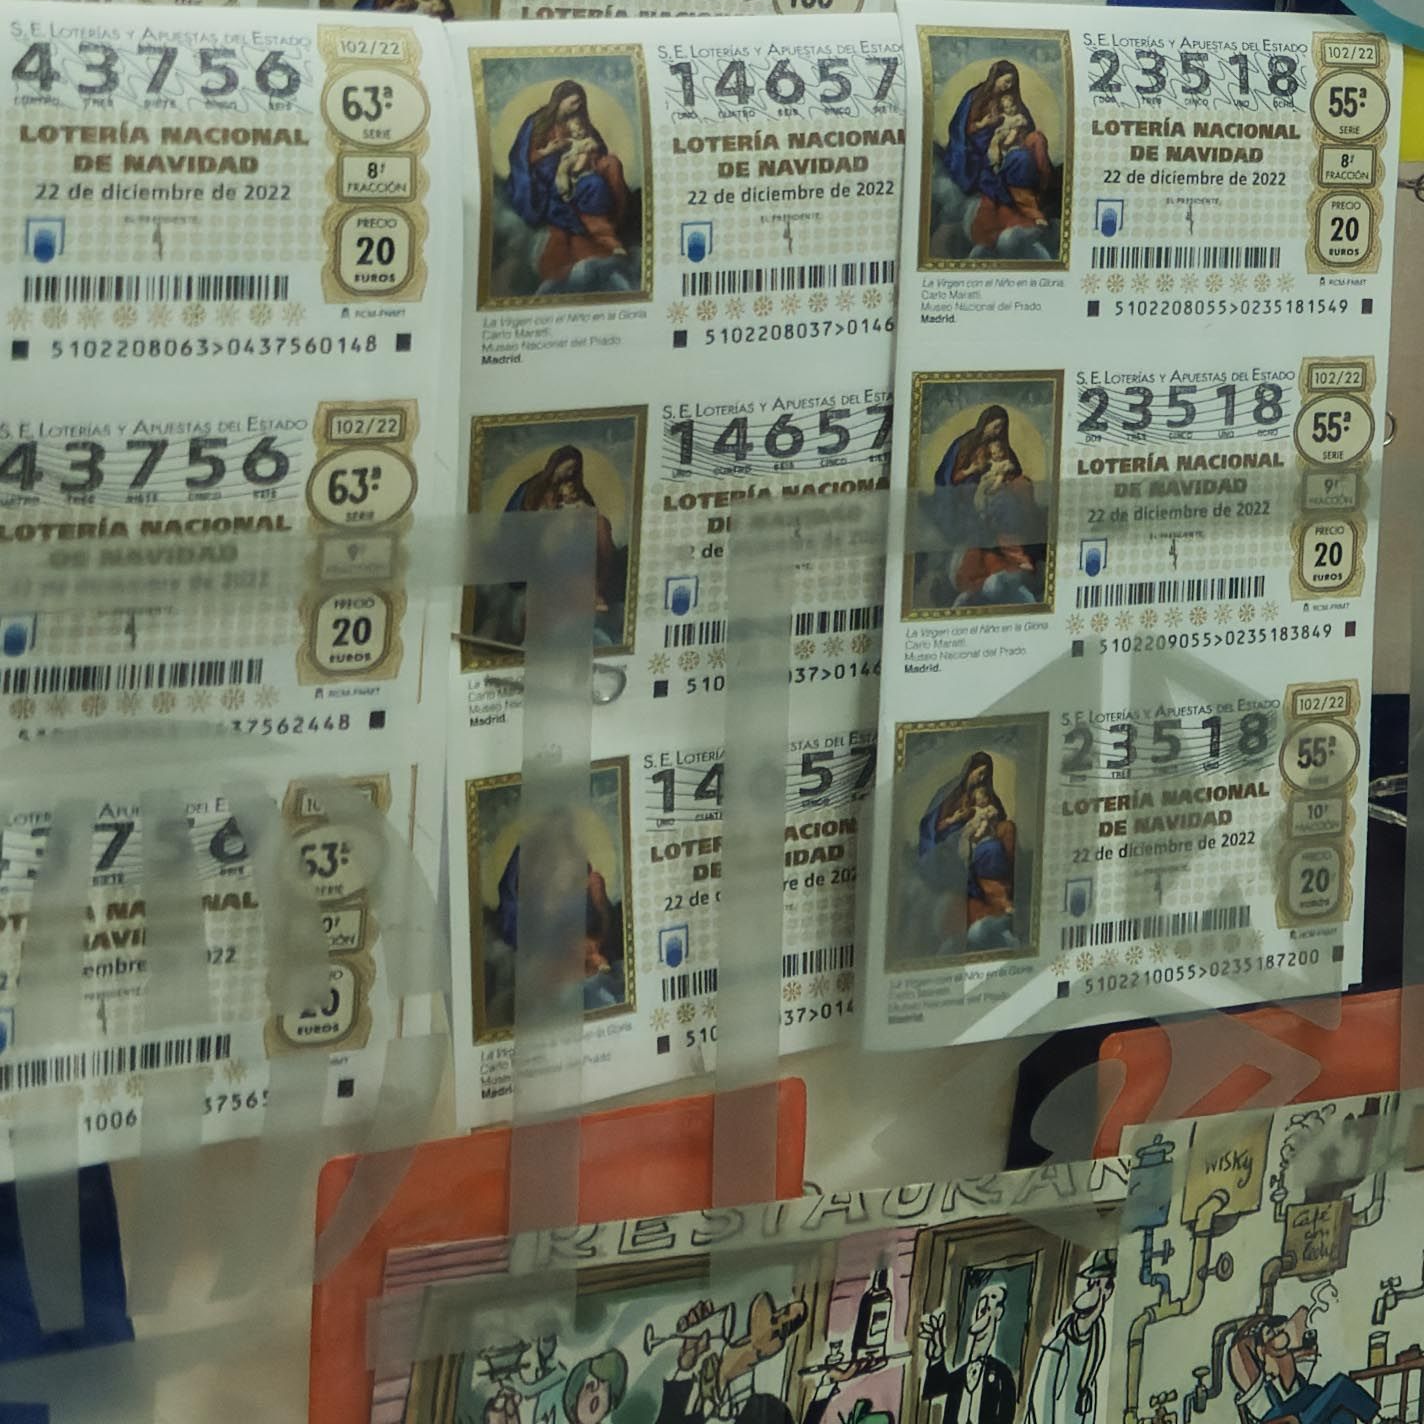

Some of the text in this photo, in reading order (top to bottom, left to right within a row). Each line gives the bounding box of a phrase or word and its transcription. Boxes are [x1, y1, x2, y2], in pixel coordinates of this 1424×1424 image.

[12, 41, 302, 99] 43756
[668, 56, 899, 107] 14657
[1088, 50, 1299, 97] 23518
[1092, 117, 1301, 141] LOTERÍA NACIONAL
[1130, 145, 1264, 164] DE NAVIDAD
[1329, 217, 1359, 242] 20
[355, 236, 395, 266] 20
[1078, 383, 1285, 434] 23518
[0, 436, 291, 493] 43756
[1314, 541, 1343, 568] 20
[332, 617, 371, 647] 20
[1061, 713, 1271, 775] 23518
[1301, 867, 1330, 893] 20
